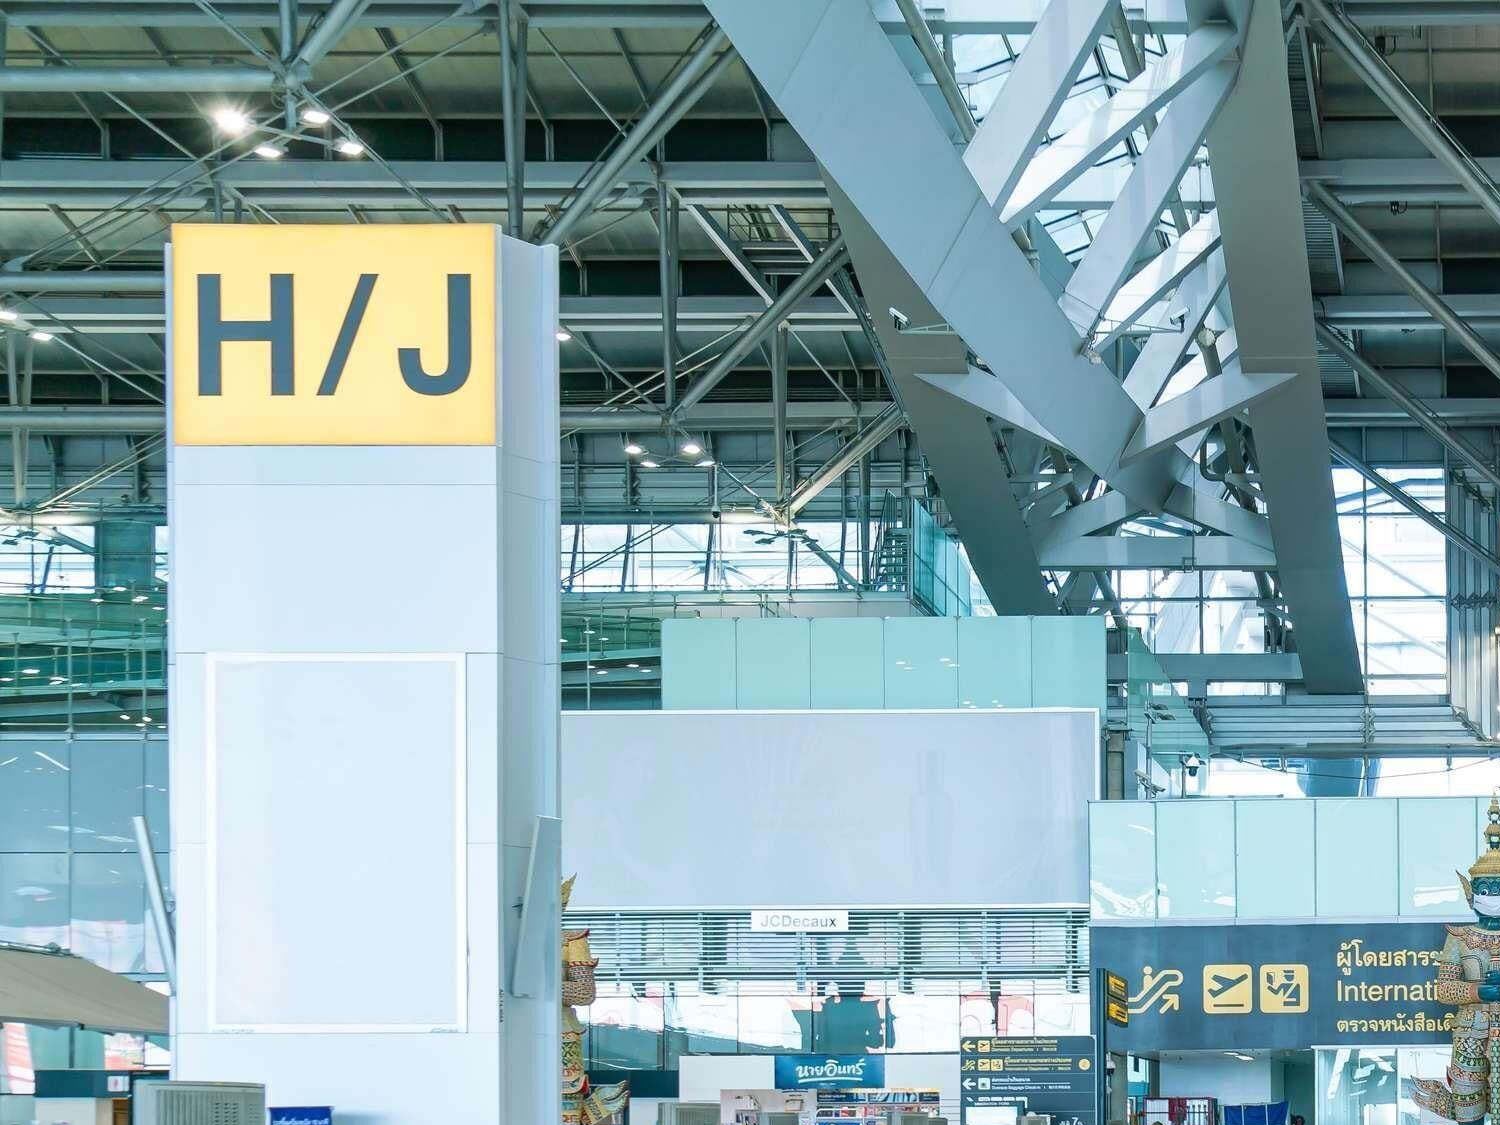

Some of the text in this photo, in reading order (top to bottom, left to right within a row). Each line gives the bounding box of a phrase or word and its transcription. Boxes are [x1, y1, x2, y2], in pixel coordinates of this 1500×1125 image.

[197, 273, 472, 396] H/J
[760, 914, 837, 928] JCDecaux
[1337, 980, 1438, 1002] Internati
[796, 1058, 867, 1078] นายอินทร์
